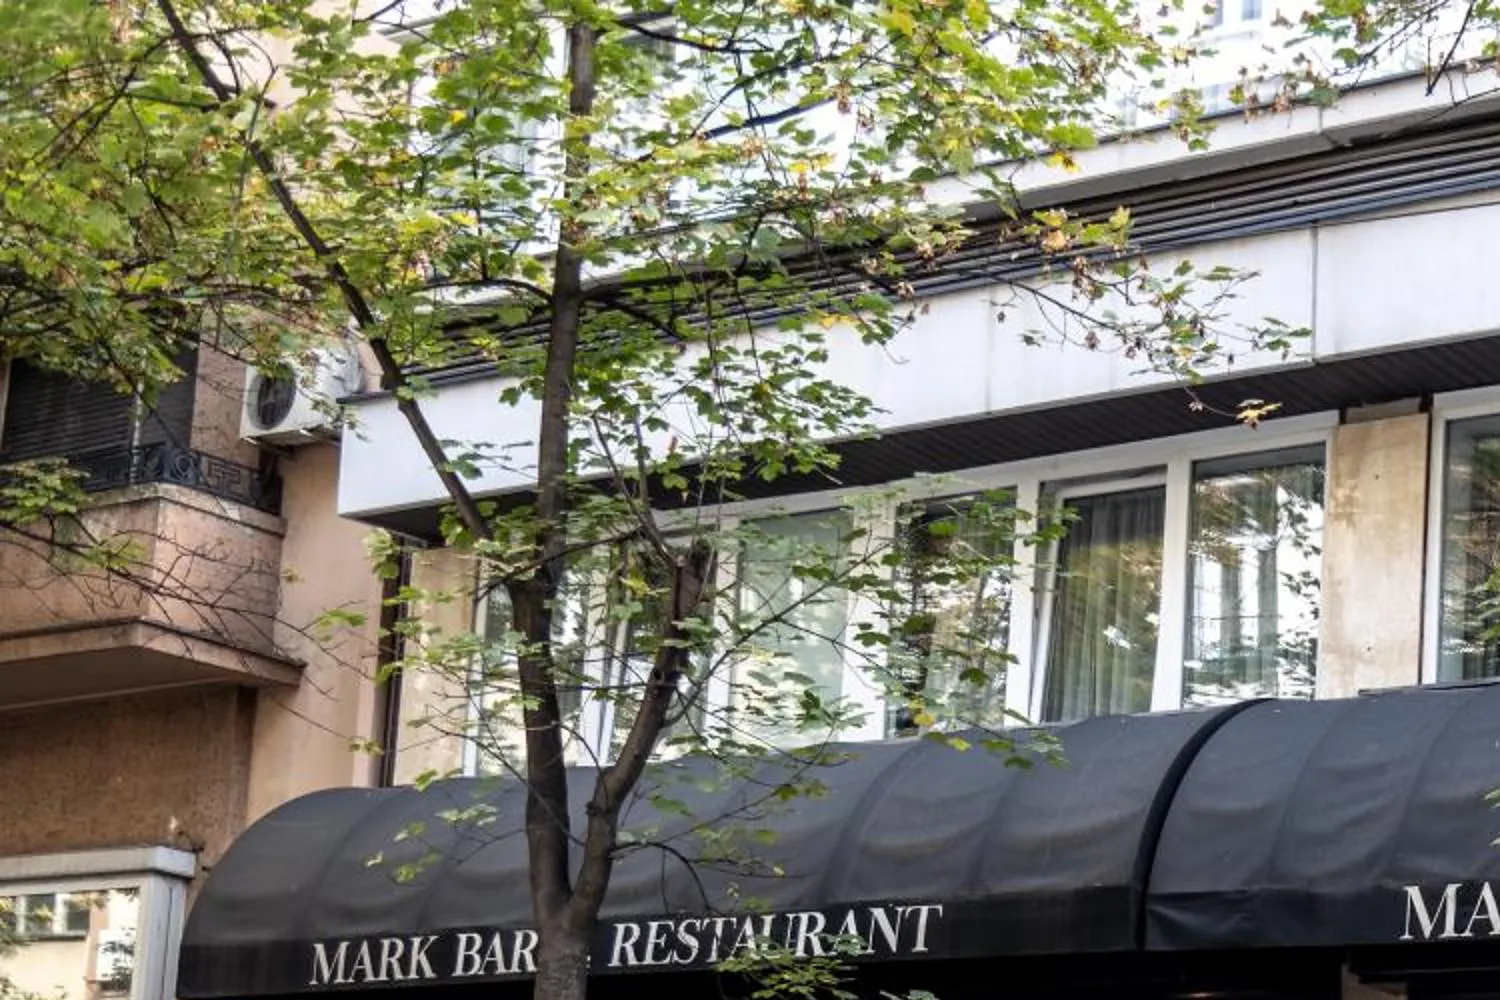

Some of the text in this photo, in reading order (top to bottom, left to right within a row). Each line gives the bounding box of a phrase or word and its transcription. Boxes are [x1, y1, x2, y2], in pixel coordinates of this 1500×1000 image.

[309, 904, 943, 985] MARK BAR RESTAURANT
